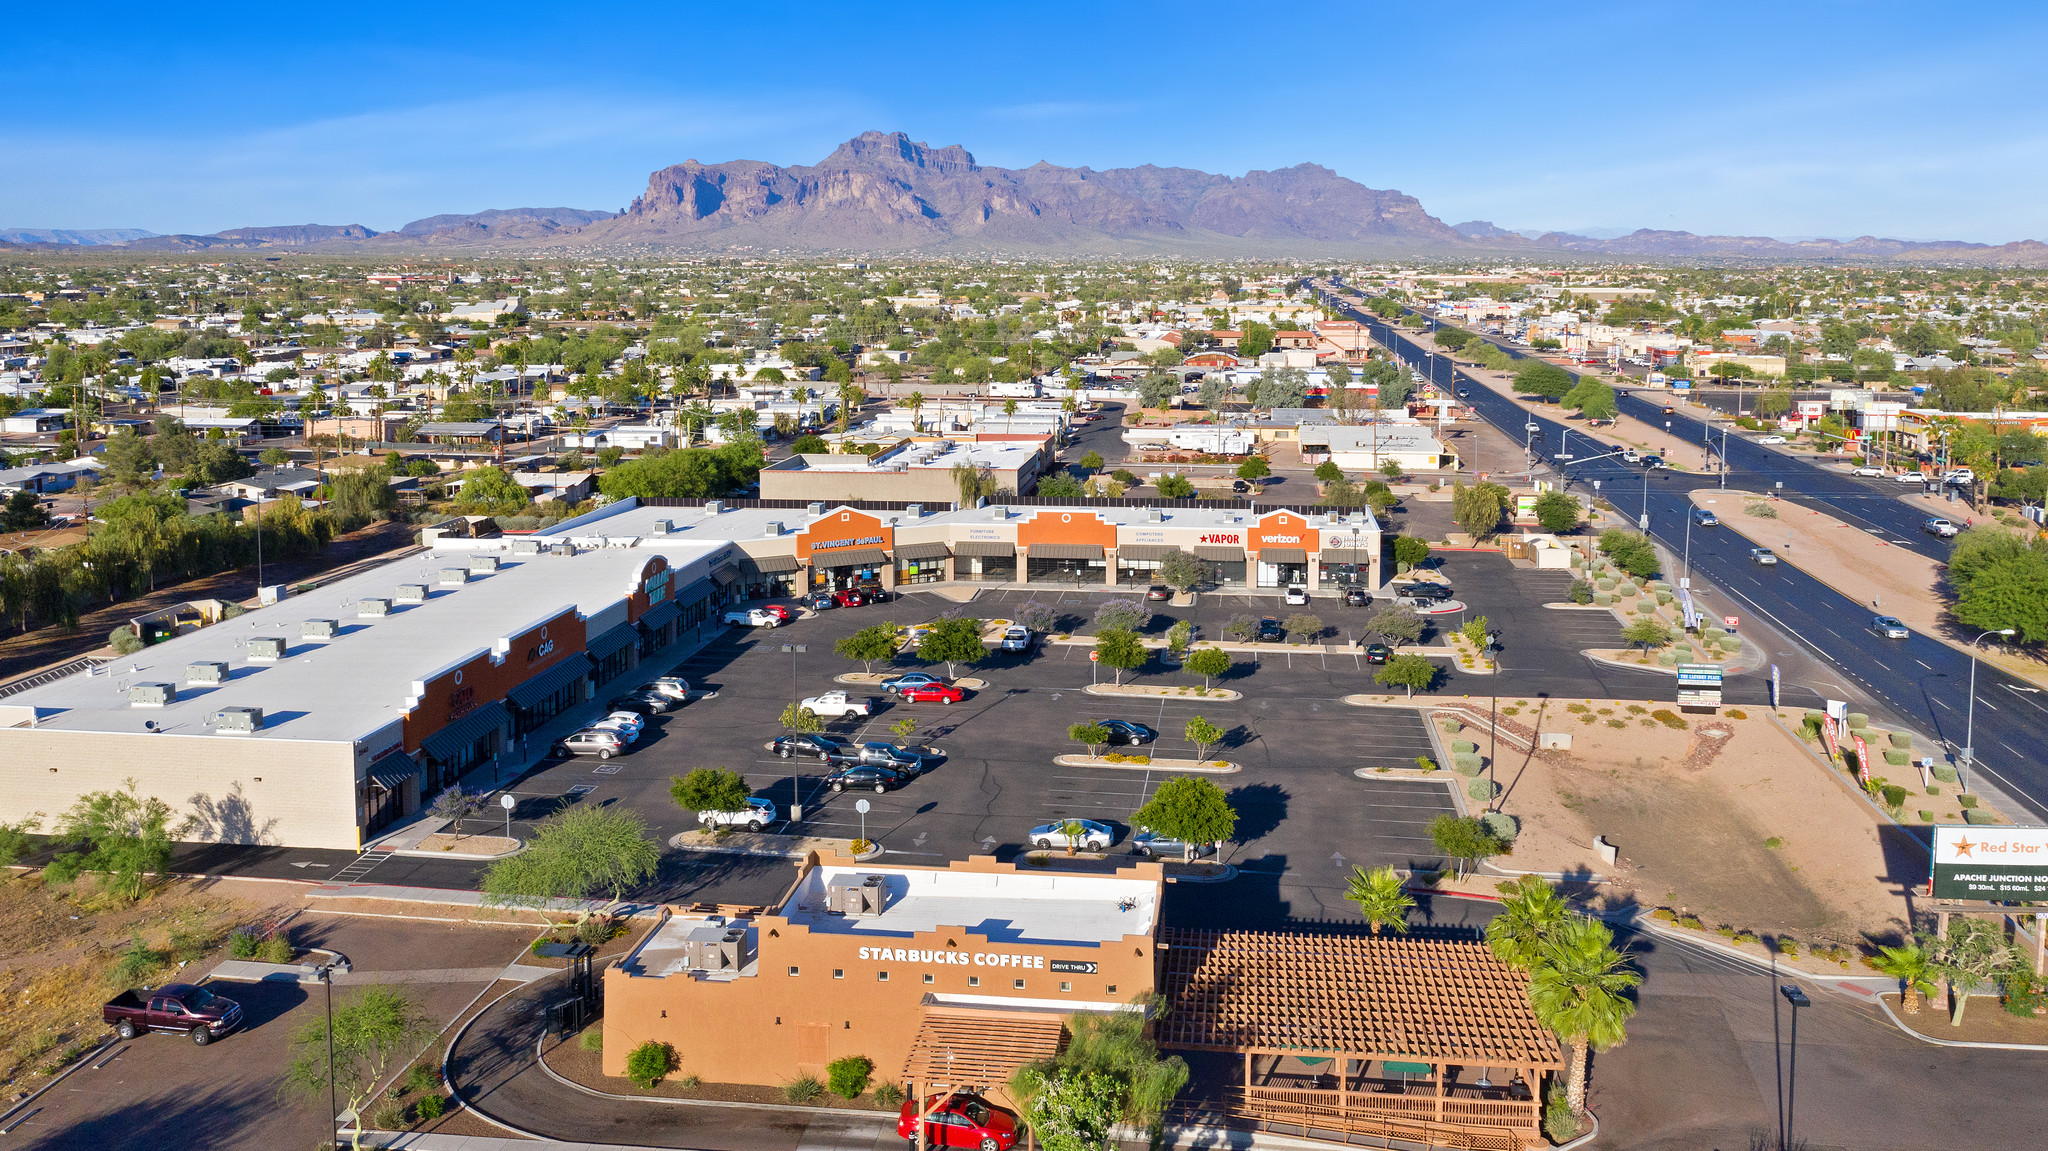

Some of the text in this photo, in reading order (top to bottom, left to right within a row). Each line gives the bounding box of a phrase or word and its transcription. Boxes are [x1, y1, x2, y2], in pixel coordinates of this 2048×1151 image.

[1208, 534, 1239, 544] VAPOR
[1261, 534, 1300, 544] verizon
[538, 639, 554, 657] CAG
[1981, 841, 2007, 853] Red
[2012, 842, 2041, 853] Star
[1953, 874, 1987, 882] APACHE
[1989, 874, 2032, 882] JUNCTION
[859, 946, 1045, 969] STARBUCKS COFFEE
